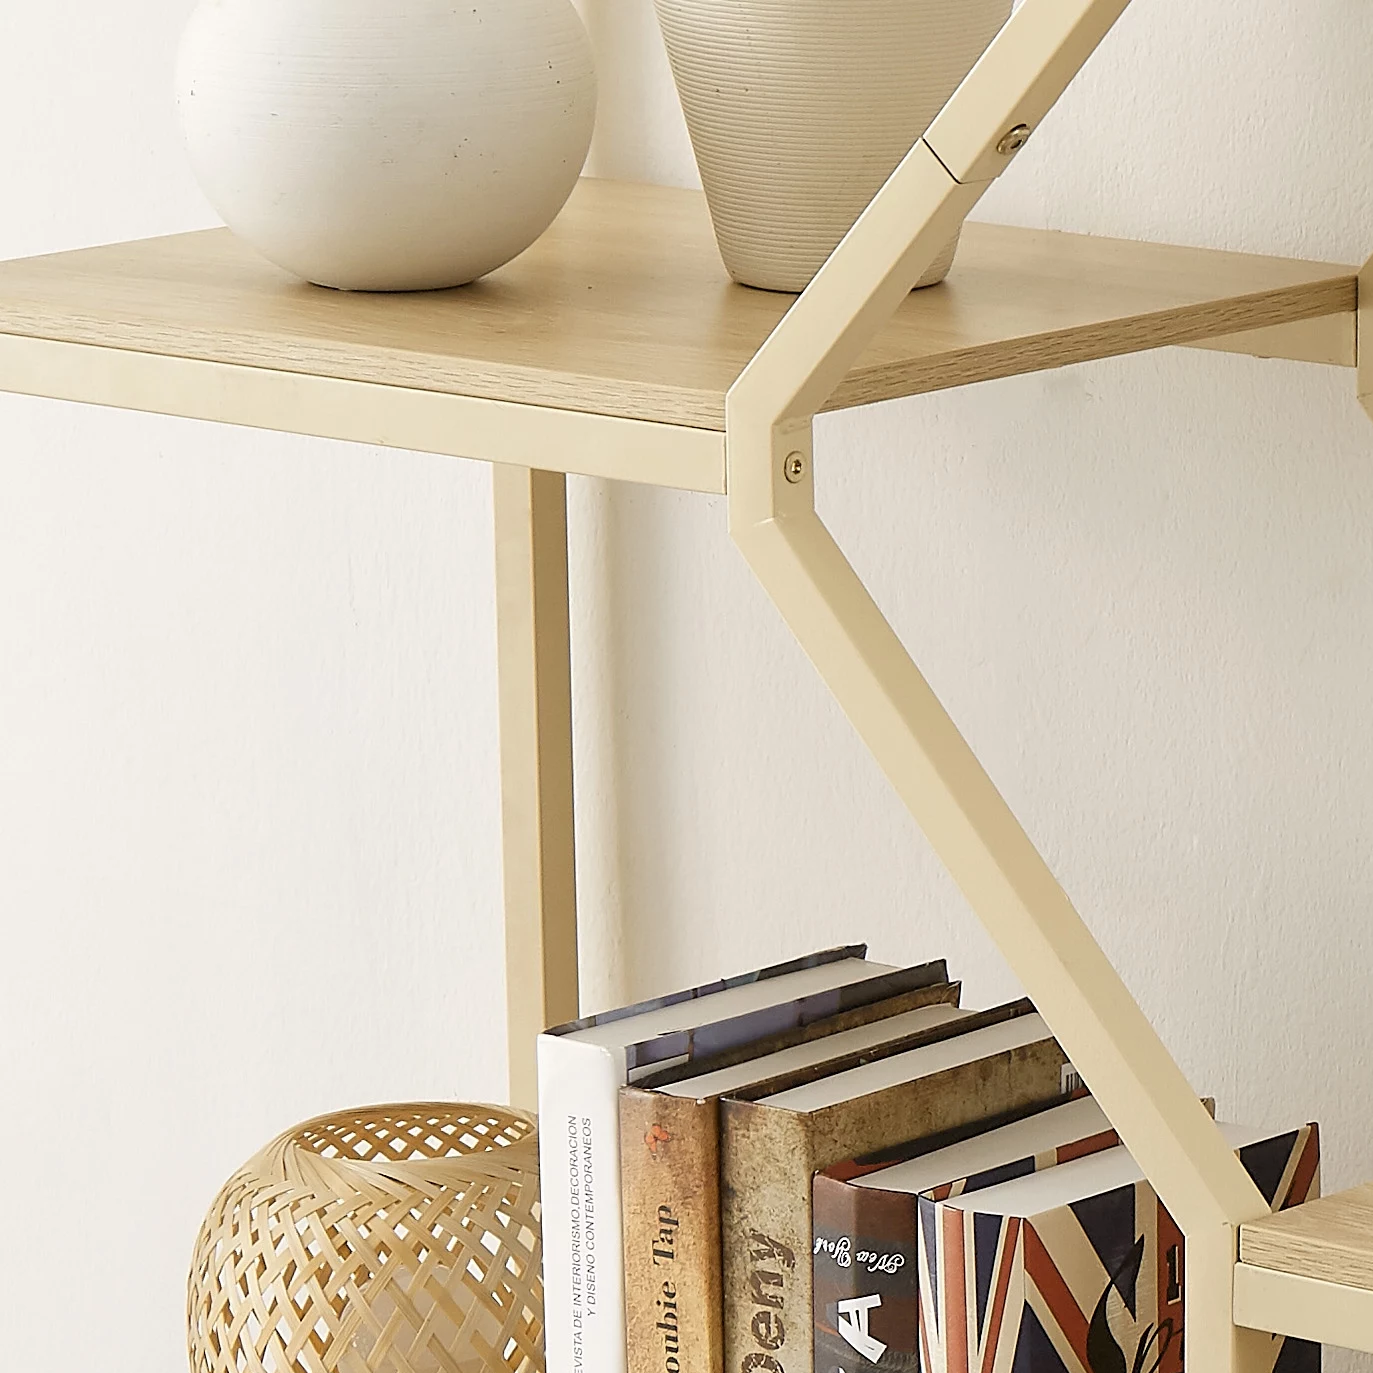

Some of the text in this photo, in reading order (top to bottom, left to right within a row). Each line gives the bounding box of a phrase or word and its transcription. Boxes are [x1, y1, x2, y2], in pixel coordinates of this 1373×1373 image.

[581, 1116, 595, 1251] CONTEMPORANEOS
[651, 1204, 680, 1267] Tap
[571, 1308, 583, 1330] DE
[586, 1307, 597, 1317] Y
